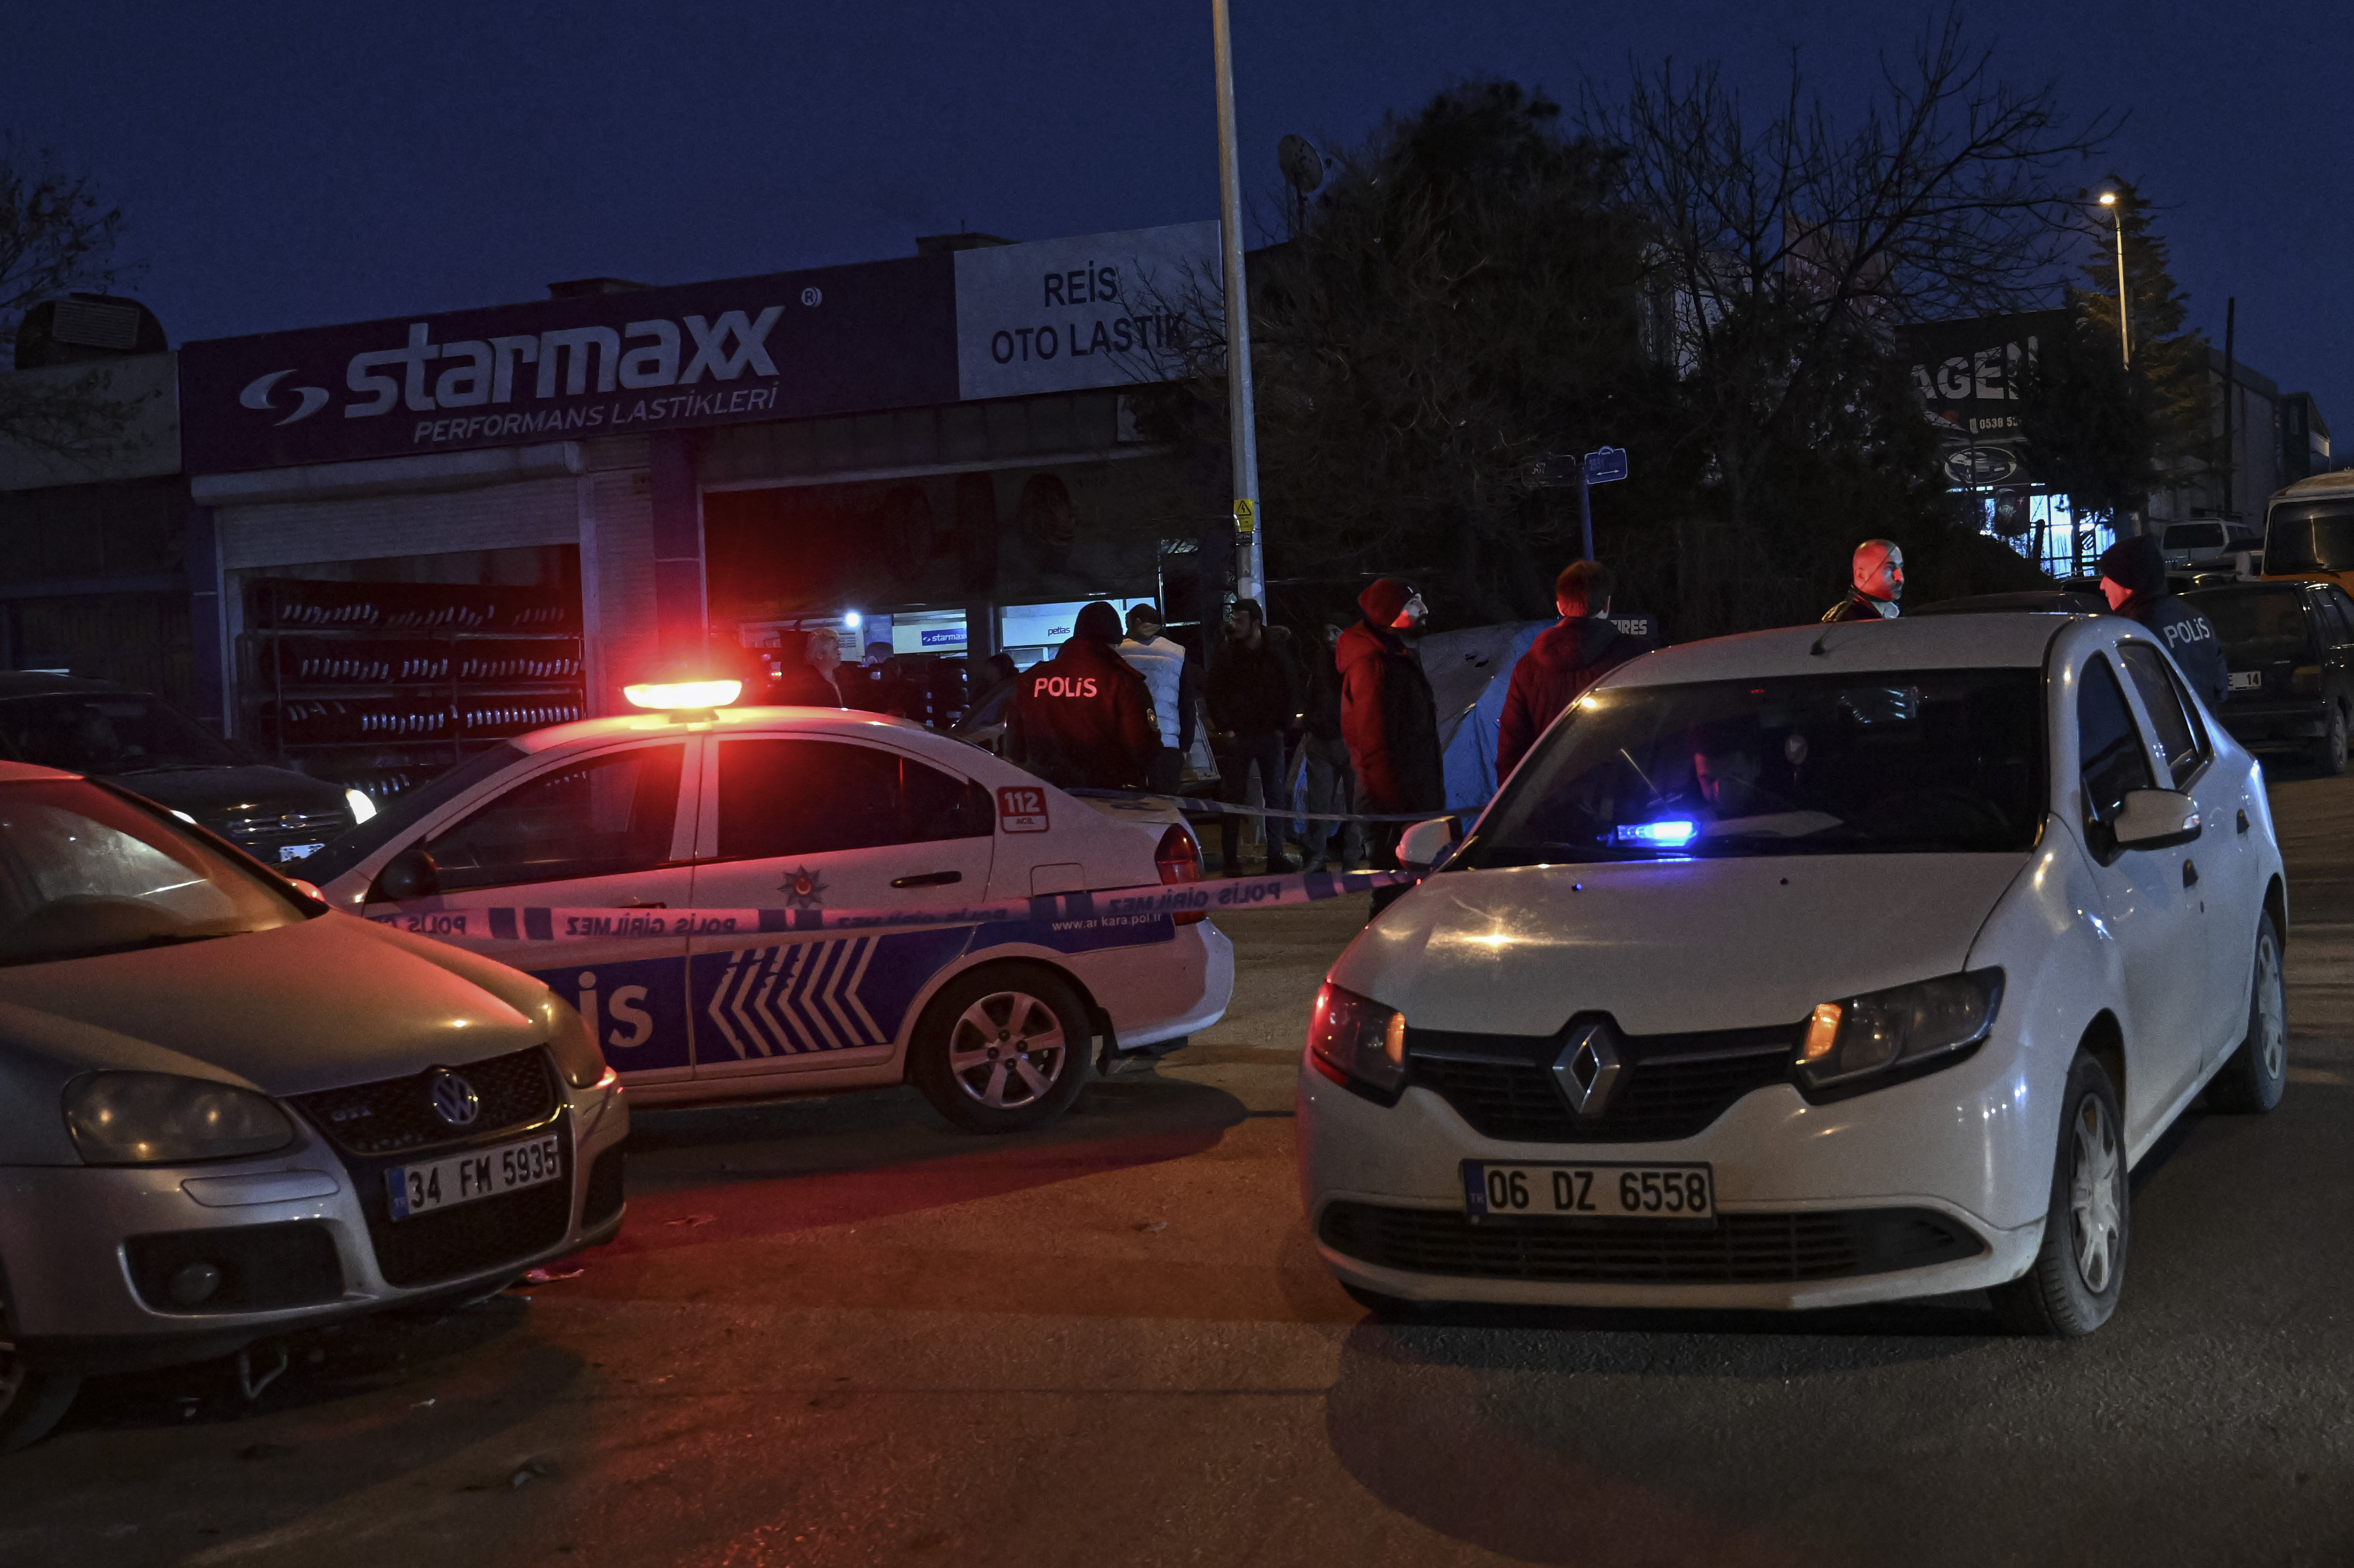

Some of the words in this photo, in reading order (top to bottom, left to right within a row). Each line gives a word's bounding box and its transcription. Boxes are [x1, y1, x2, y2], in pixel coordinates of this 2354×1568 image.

[1044, 261, 1118, 307] REİS
[992, 326, 1058, 364] OTO
[1070, 306, 1186, 357] LASTİK
[345, 305, 786, 419] starmaxx
[414, 405, 605, 443] PERFORMANS
[611, 382, 779, 424] LASTİKLERİ
[1048, 626, 1071, 637] petlas
[1005, 792, 1041, 813] 112
[408, 1167, 441, 1208] 34
[503, 1141, 558, 1186] 5935
[1487, 1170, 1529, 1209] 06
[1553, 1170, 1596, 1211] DZ
[1619, 1172, 1707, 1212] 6558
